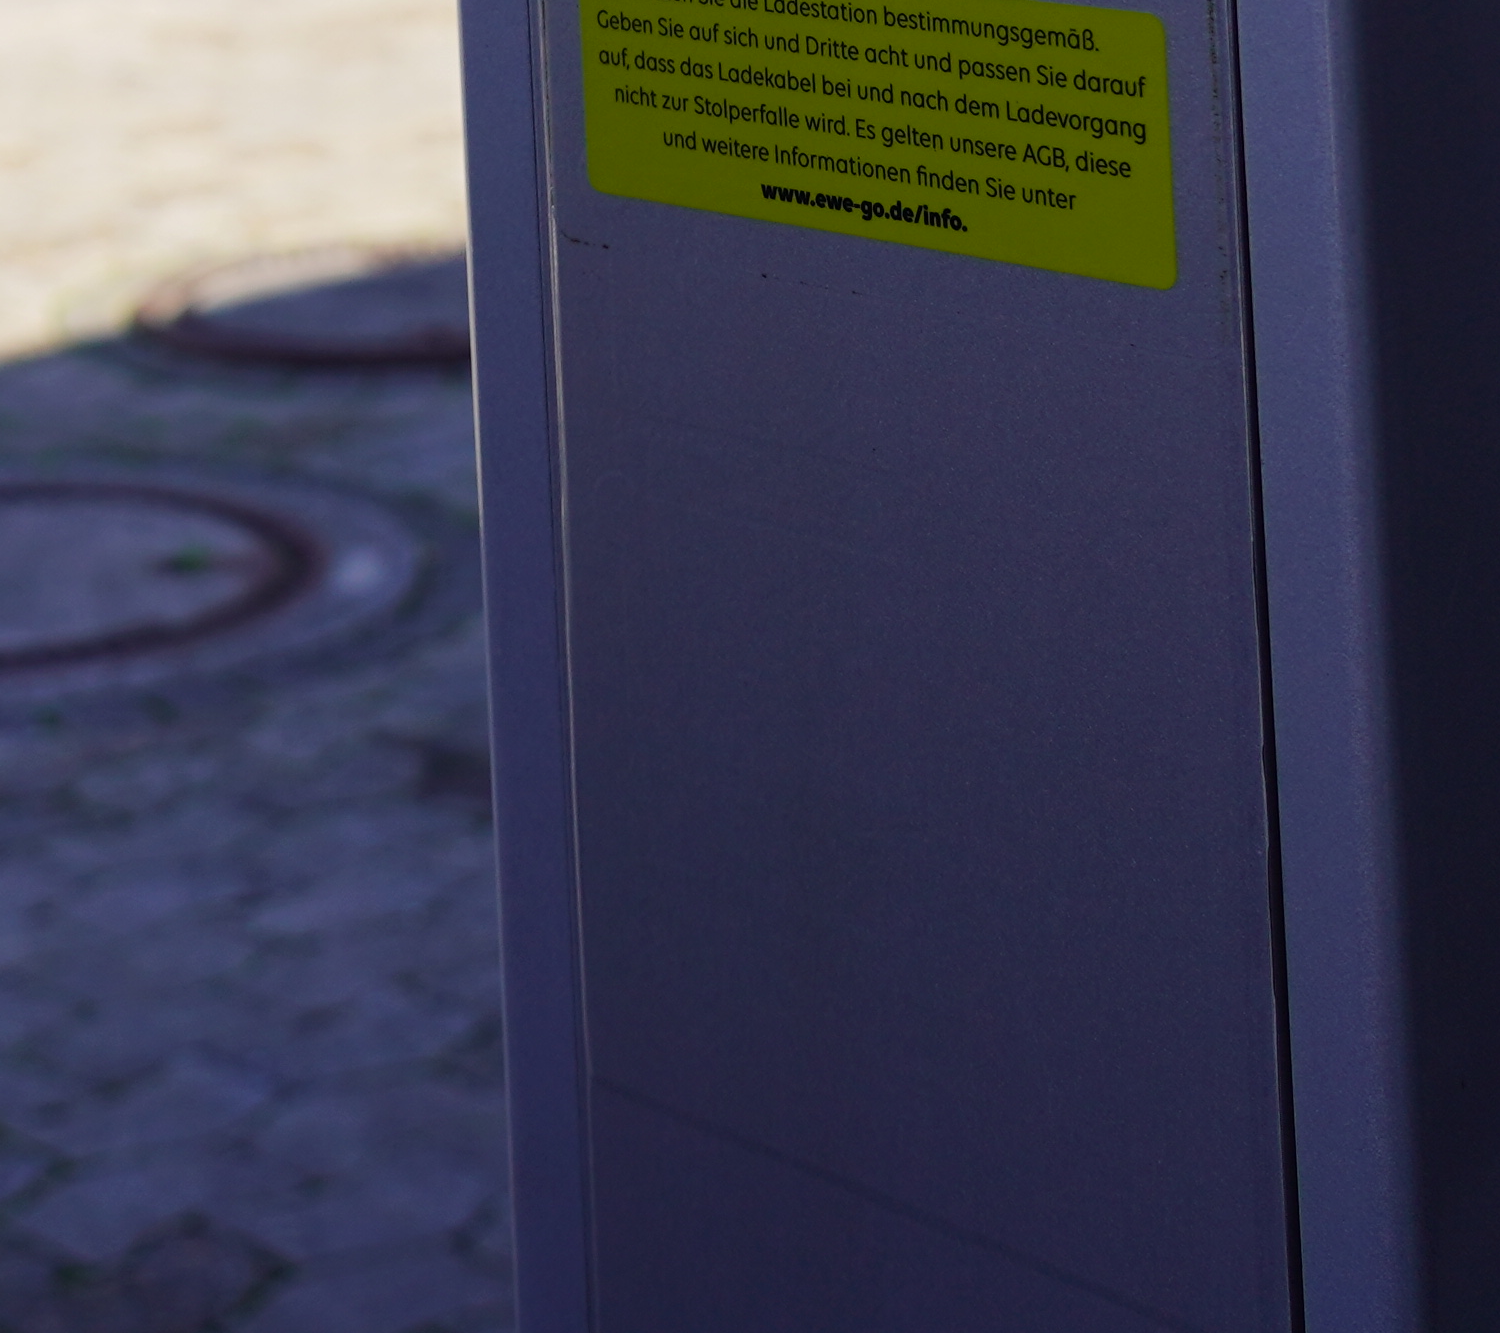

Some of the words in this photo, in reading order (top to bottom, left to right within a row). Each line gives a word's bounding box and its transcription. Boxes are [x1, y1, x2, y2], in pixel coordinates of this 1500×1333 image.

[884, 6, 1099, 51] bestimmungsgemäß.
[664, 131, 696, 150] und
[702, 137, 769, 161] weitere
[775, 145, 910, 184] Informationen
[916, 165, 979, 195] finden
[986, 177, 1015, 200] Sie
[1022, 188, 1076, 210] unter
[761, 184, 968, 232] www.ewe-go.de/info.
